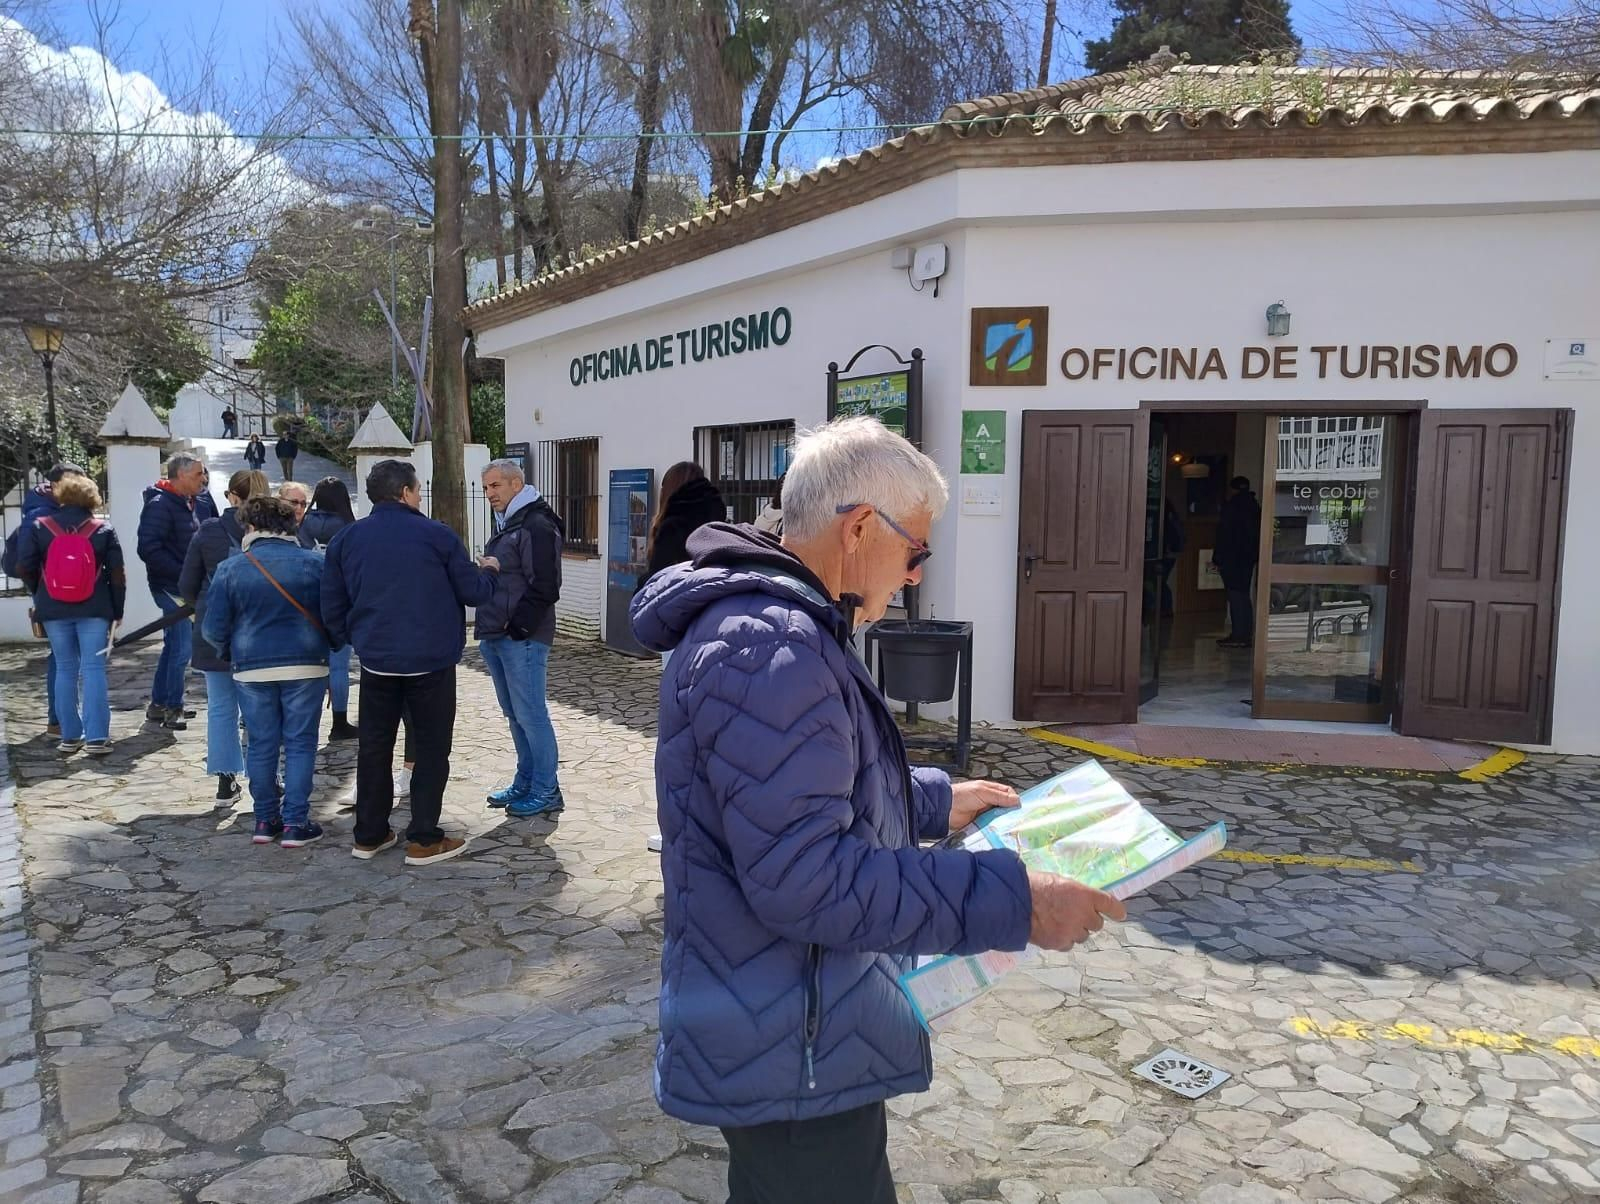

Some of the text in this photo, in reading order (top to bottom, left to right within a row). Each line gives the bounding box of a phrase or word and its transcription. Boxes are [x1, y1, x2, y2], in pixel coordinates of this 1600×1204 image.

[570, 306, 792, 387] OFICINA DE TURISMO
[1060, 342, 1519, 381] OFICINA DE TURISMO
[1292, 482, 1379, 503] te cobija
